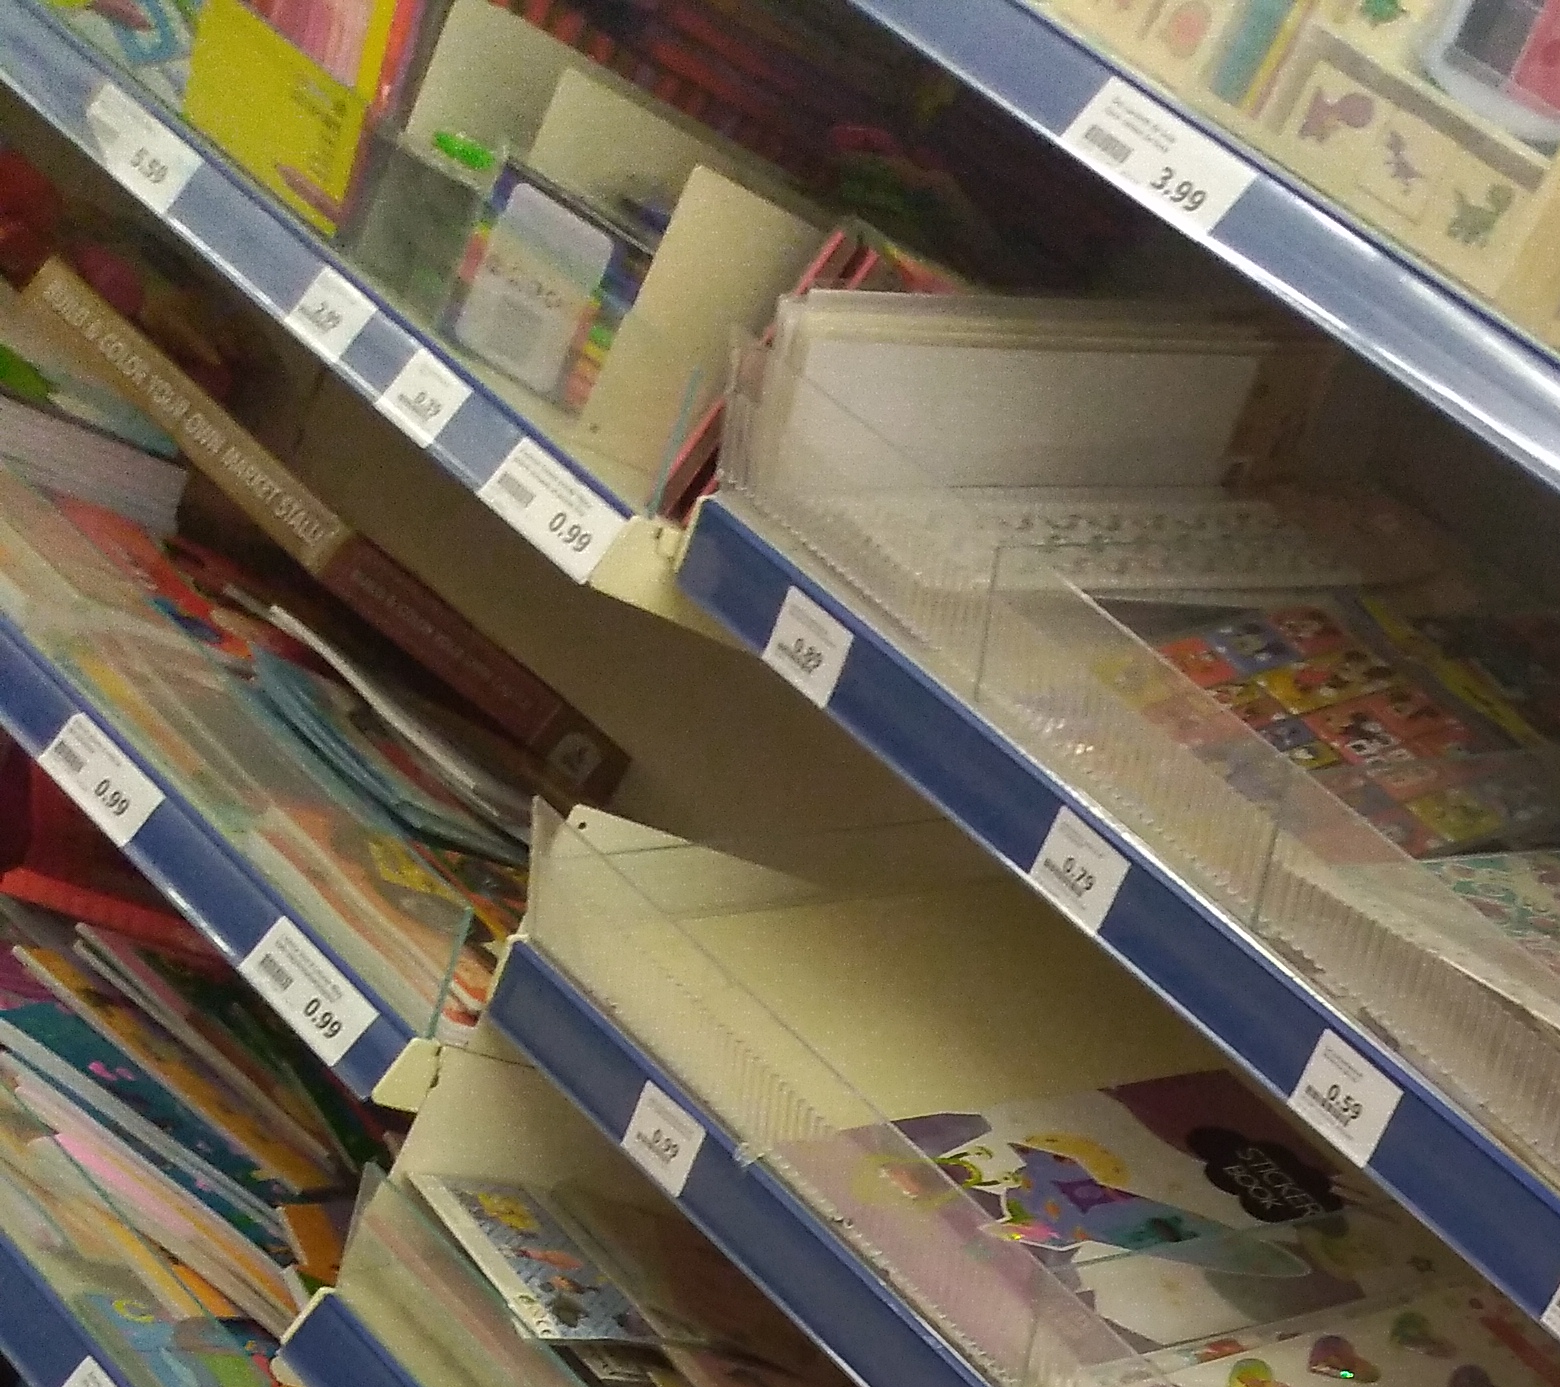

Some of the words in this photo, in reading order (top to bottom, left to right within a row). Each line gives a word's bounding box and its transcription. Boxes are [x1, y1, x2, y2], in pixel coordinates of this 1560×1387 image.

[1149, 166, 1209, 213] 3.99
[180, 409, 230, 457] OWN
[218, 444, 283, 506] MARKET
[546, 509, 594, 554] 0.99
[91, 777, 131, 818] 0.99
[1062, 854, 1095, 893] 0.79
[300, 996, 343, 1042] 0.99
[1325, 1081, 1363, 1122] 0.59
[1222, 1154, 1285, 1217] BOOK
[1233, 1133, 1326, 1226] STICKER
